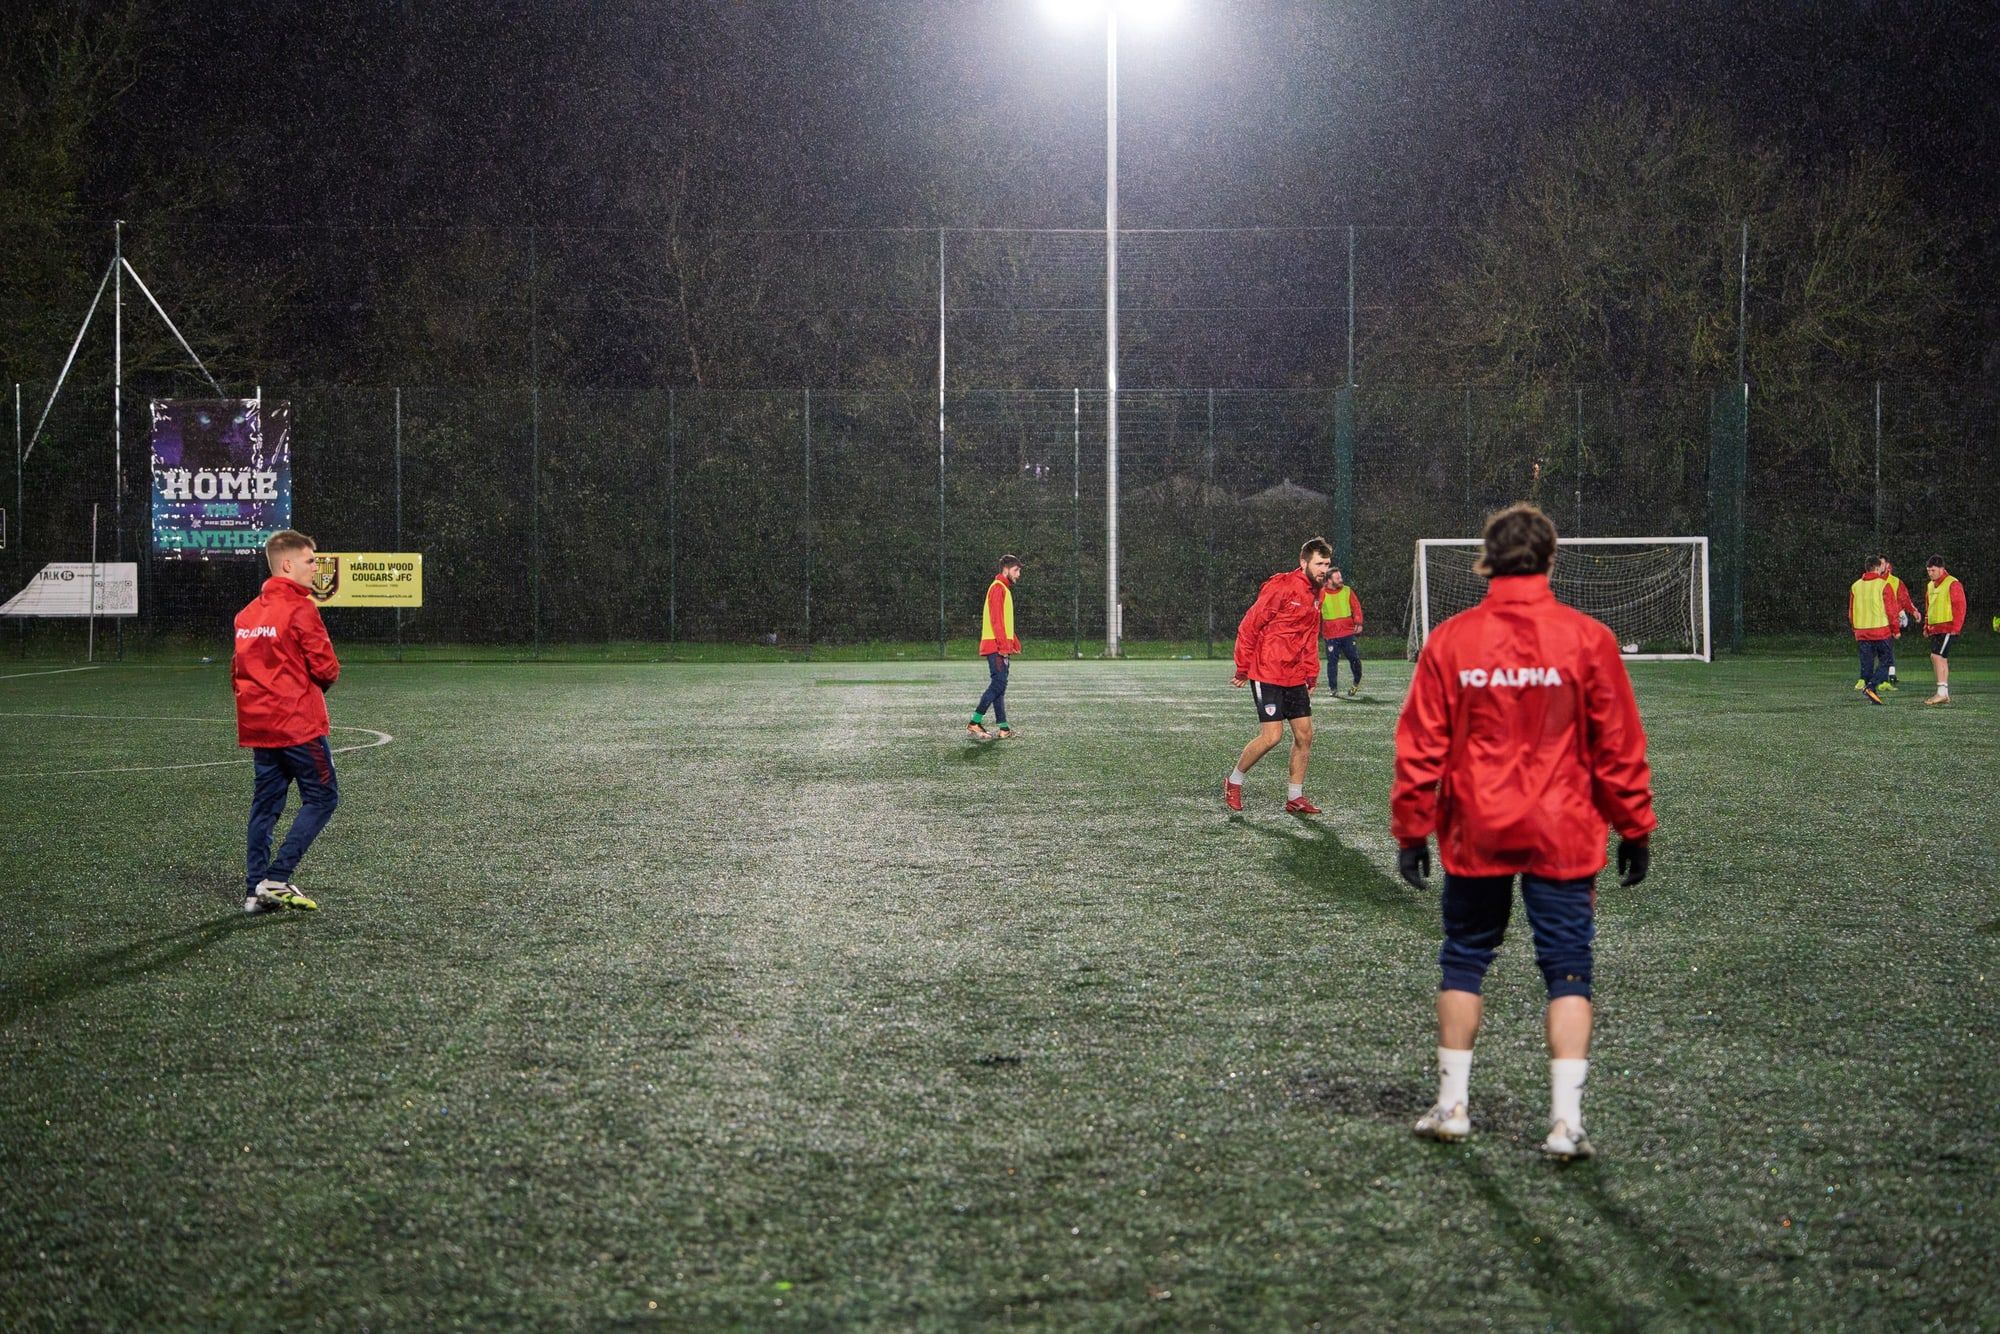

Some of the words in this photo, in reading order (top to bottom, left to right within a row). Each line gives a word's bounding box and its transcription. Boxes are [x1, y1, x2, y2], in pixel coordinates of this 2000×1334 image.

[163, 471, 278, 500] HOME
[160, 530, 273, 548] PANTHER
[350, 563, 385, 571] HAROLD
[387, 563, 414, 571] WOOD
[40, 571, 60, 581] TALK
[352, 574, 393, 582] COUGARS
[396, 574, 412, 582] JFC
[236, 629, 250, 639] FC
[250, 626, 277, 638] ALPHA
[1459, 668, 1488, 688] FC
[1490, 667, 1562, 688] ALPHA
